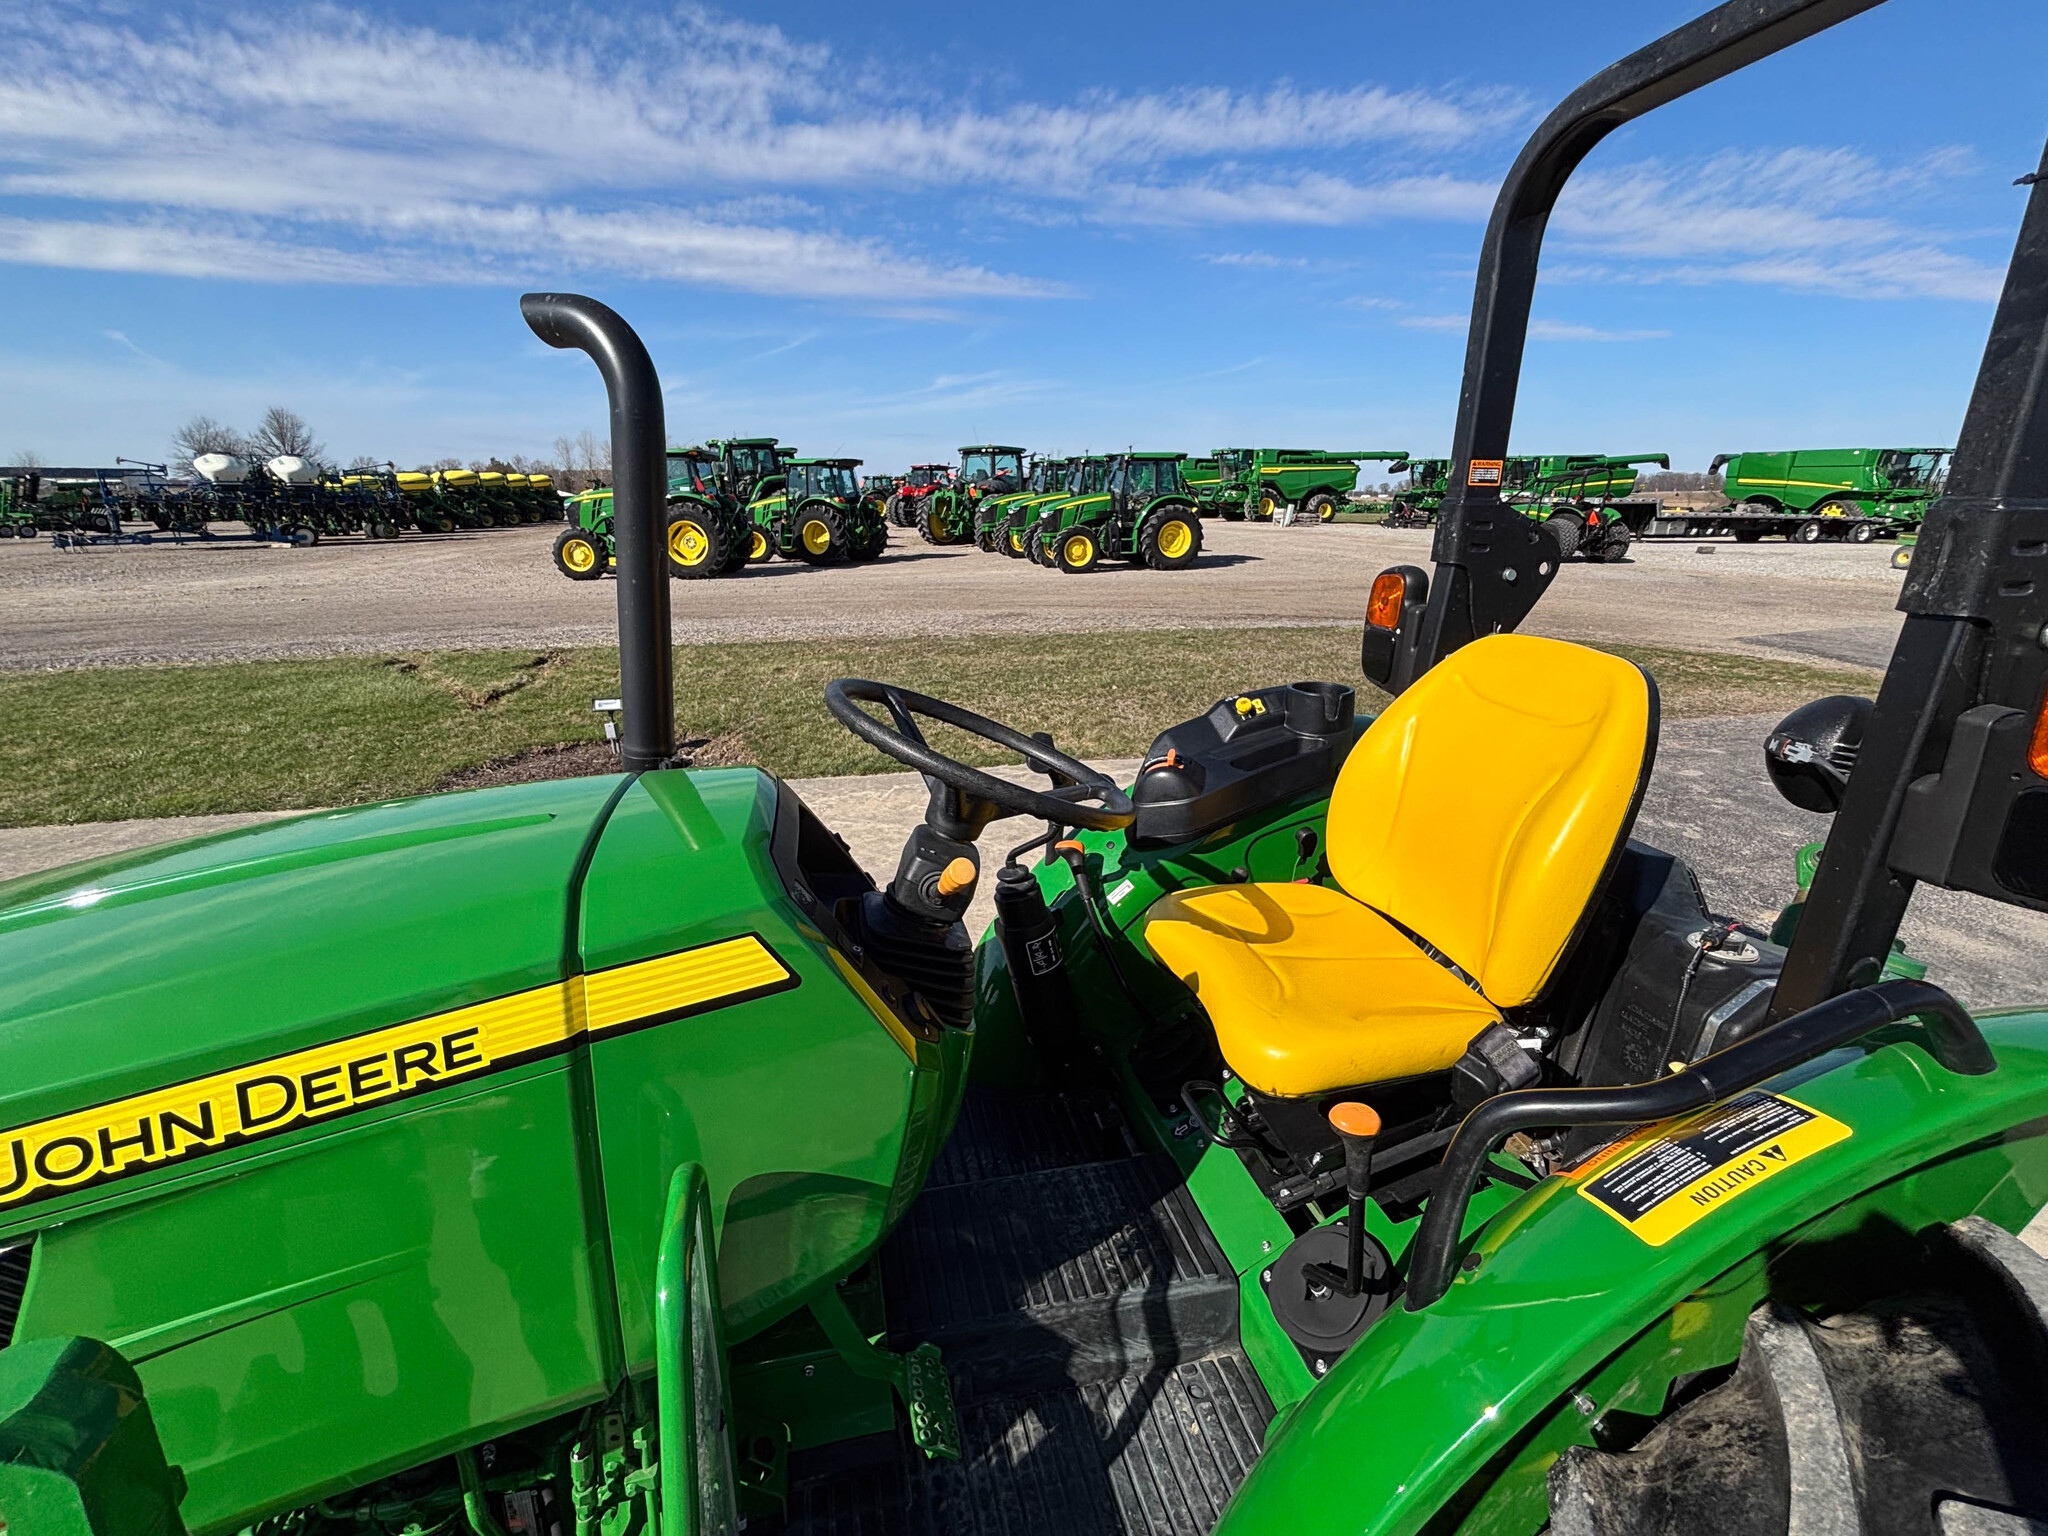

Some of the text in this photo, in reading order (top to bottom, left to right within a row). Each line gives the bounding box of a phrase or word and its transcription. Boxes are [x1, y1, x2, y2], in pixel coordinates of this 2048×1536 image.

[0, 1027, 484, 1197] JOHN DEERE
[1689, 1159, 1767, 1206] CAUTION
